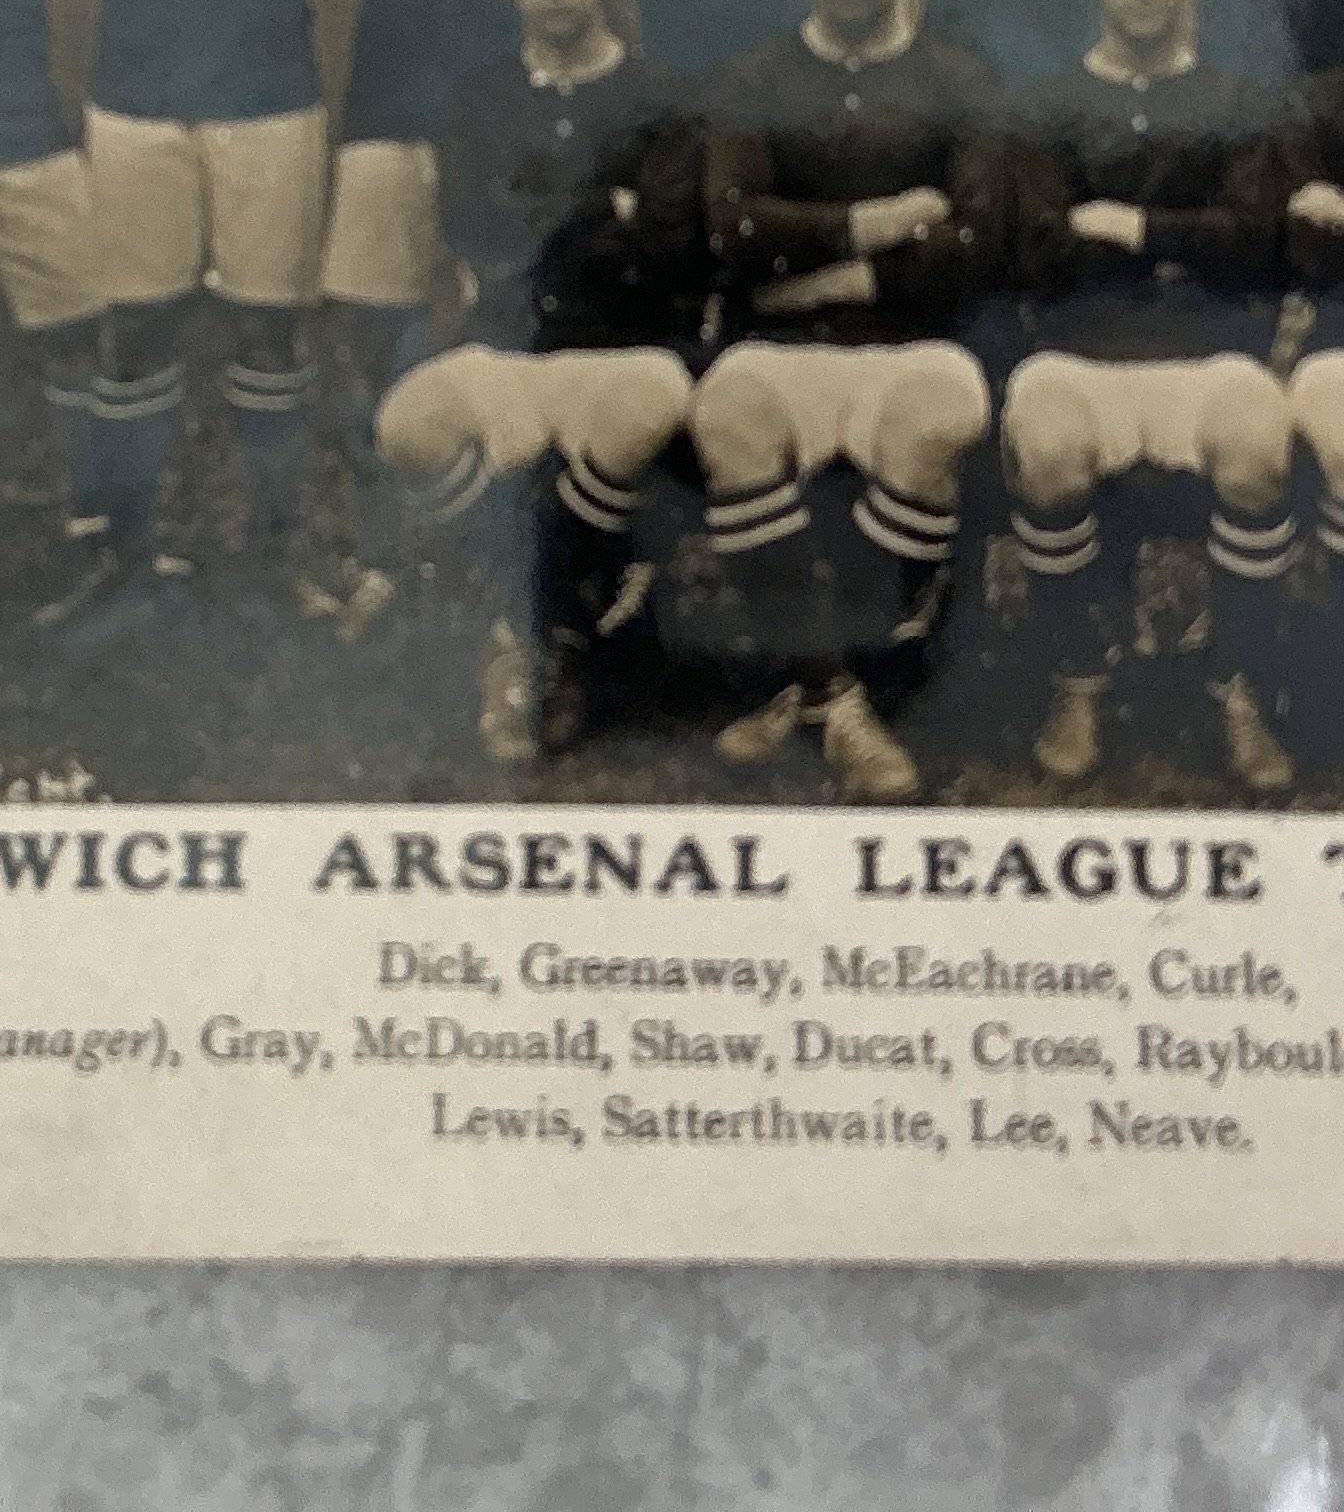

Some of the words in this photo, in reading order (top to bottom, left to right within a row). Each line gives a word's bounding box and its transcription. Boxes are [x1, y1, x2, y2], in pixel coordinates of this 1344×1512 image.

[313, 831, 791, 899] ARSENAL
[854, 836, 1265, 904] LEAGUE
[377, 941, 501, 998] Dick,
[518, 942, 804, 1001] Greenaway,
[821, 944, 1131, 1003] McEachrane,
[1147, 948, 1298, 1005] Curle,
[198, 1014, 335, 1078] Gray,
[352, 1016, 613, 1071] McDonald,
[629, 1018, 778, 1074] Shaw,
[791, 1019, 954, 1078] Ducat,
[971, 1021, 1115, 1078] Cross,
[431, 1091, 586, 1146] Lewis,
[601, 1093, 949, 1152] Satterthwaite,
[969, 1098, 1070, 1153] Lee,
[1087, 1099, 1254, 1150] Neave.
